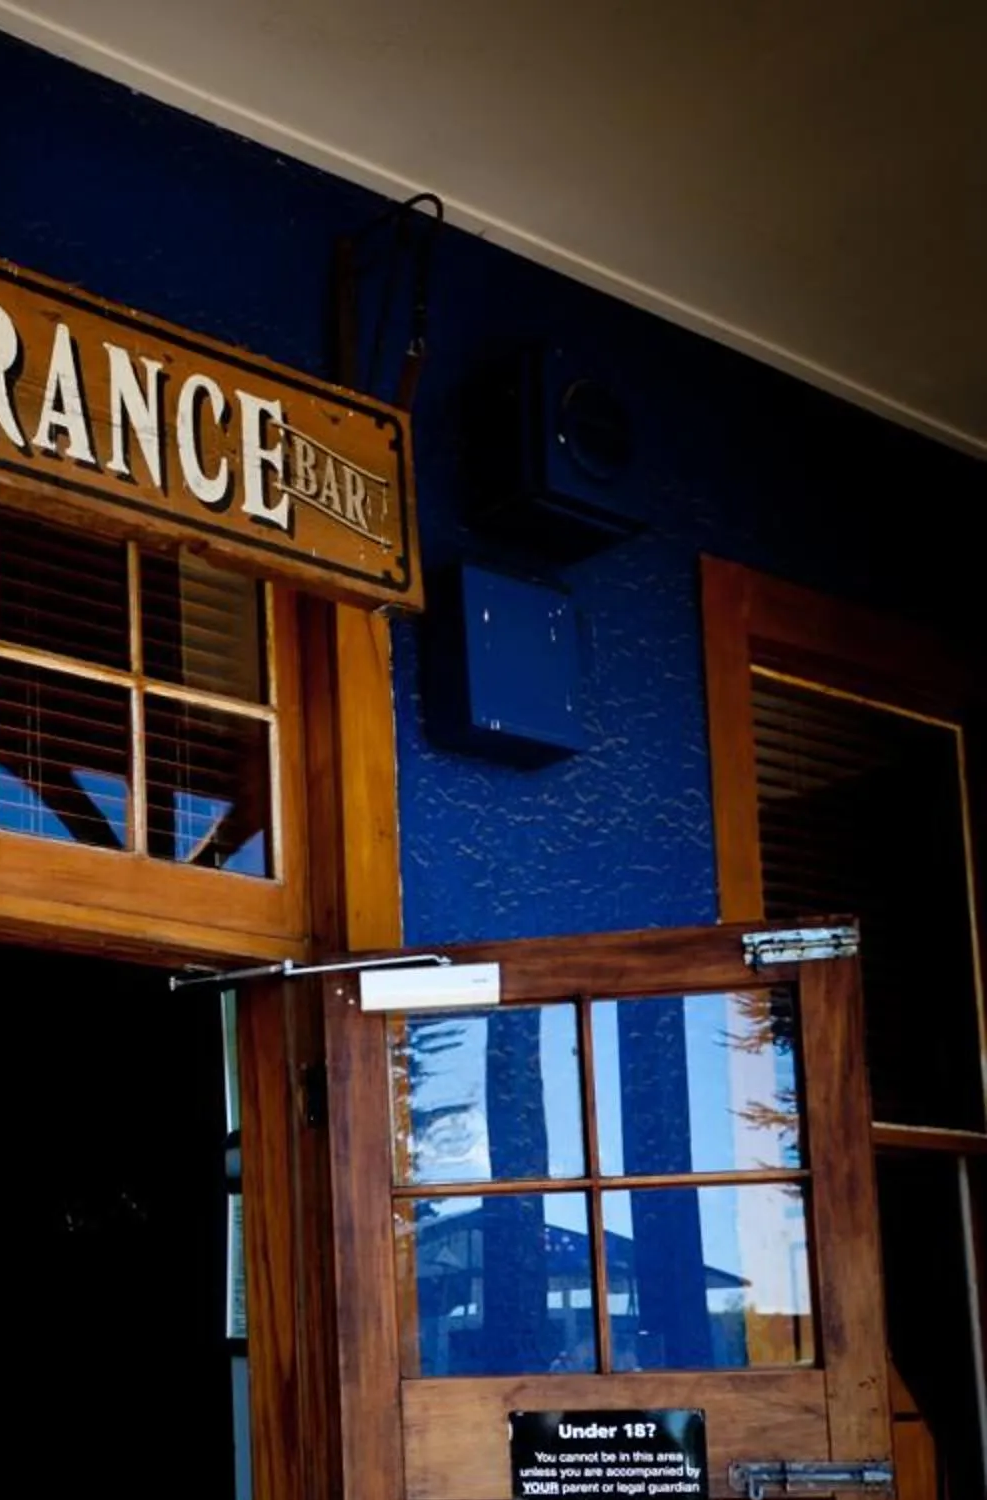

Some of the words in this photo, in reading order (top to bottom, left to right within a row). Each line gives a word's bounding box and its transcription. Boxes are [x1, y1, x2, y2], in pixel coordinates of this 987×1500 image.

[293, 435, 368, 531] BAR
[558, 1423, 617, 1439] Under
[623, 1423, 656, 1438] 18?
[534, 1452, 556, 1463] You
[558, 1452, 599, 1463] cannot
[601, 1452, 616, 1463] be
[619, 1452, 630, 1463] in
[632, 1451, 653, 1463] this
[656, 1452, 684, 1462] area
[520, 1467, 558, 1478] unless
[559, 1468, 581, 1479] you
[583, 1467, 603, 1477] are
[606, 1466, 684, 1478] accompanied
[687, 1465, 701, 1478] by
[522, 1482, 560, 1495] YOUR
[562, 1482, 599, 1495] parent
[602, 1483, 614, 1493] or
[617, 1482, 645, 1495] legal
[648, 1481, 700, 1495] guardian
